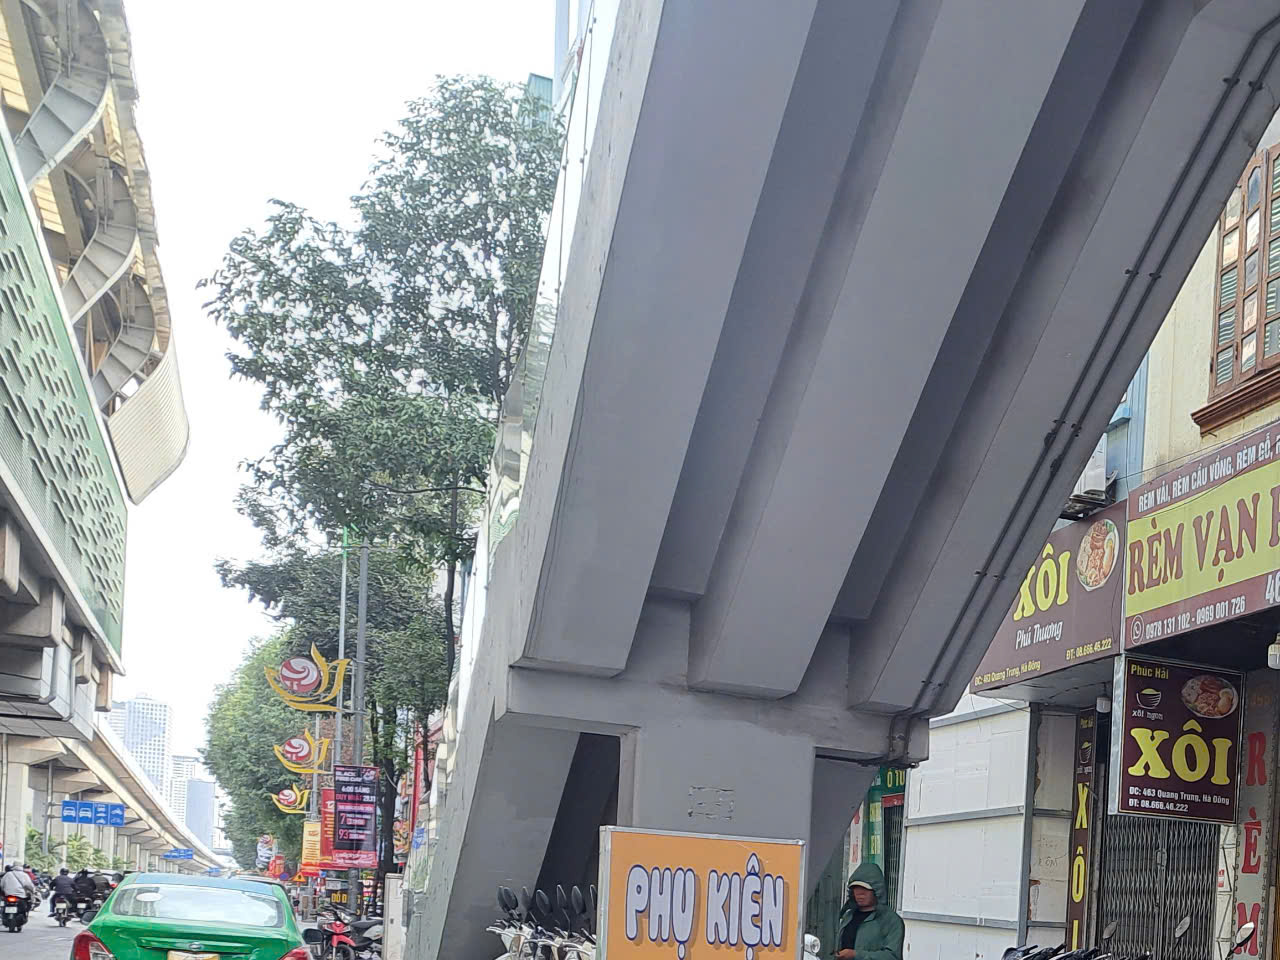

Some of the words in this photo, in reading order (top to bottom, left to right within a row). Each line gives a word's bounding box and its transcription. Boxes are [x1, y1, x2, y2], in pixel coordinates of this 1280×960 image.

[1138, 490, 1155, 513] RÈM
[1172, 475, 1190, 499] RÈM
[1236, 445, 1256, 472] RÈM
[1128, 516, 1184, 596] RÈM
[1192, 493, 1260, 583] VẠN
[1013, 543, 1071, 621] XÔI
[1015, 627, 1032, 650] Phú
[1145, 622, 1162, 639] 0978
[1163, 619, 1176, 634] 131
[1178, 616, 1191, 631] 102
[1196, 605, 1214, 624] 0969
[1216, 603, 1229, 619] 001
[1231, 595, 1246, 614] 726
[1131, 664, 1153, 677] Phúc
[1127, 719, 1232, 785] XÔI
[1142, 787, 1156, 797] 463
[1157, 789, 1179, 800] Quang
[625, 862, 696, 960] PHỤ
